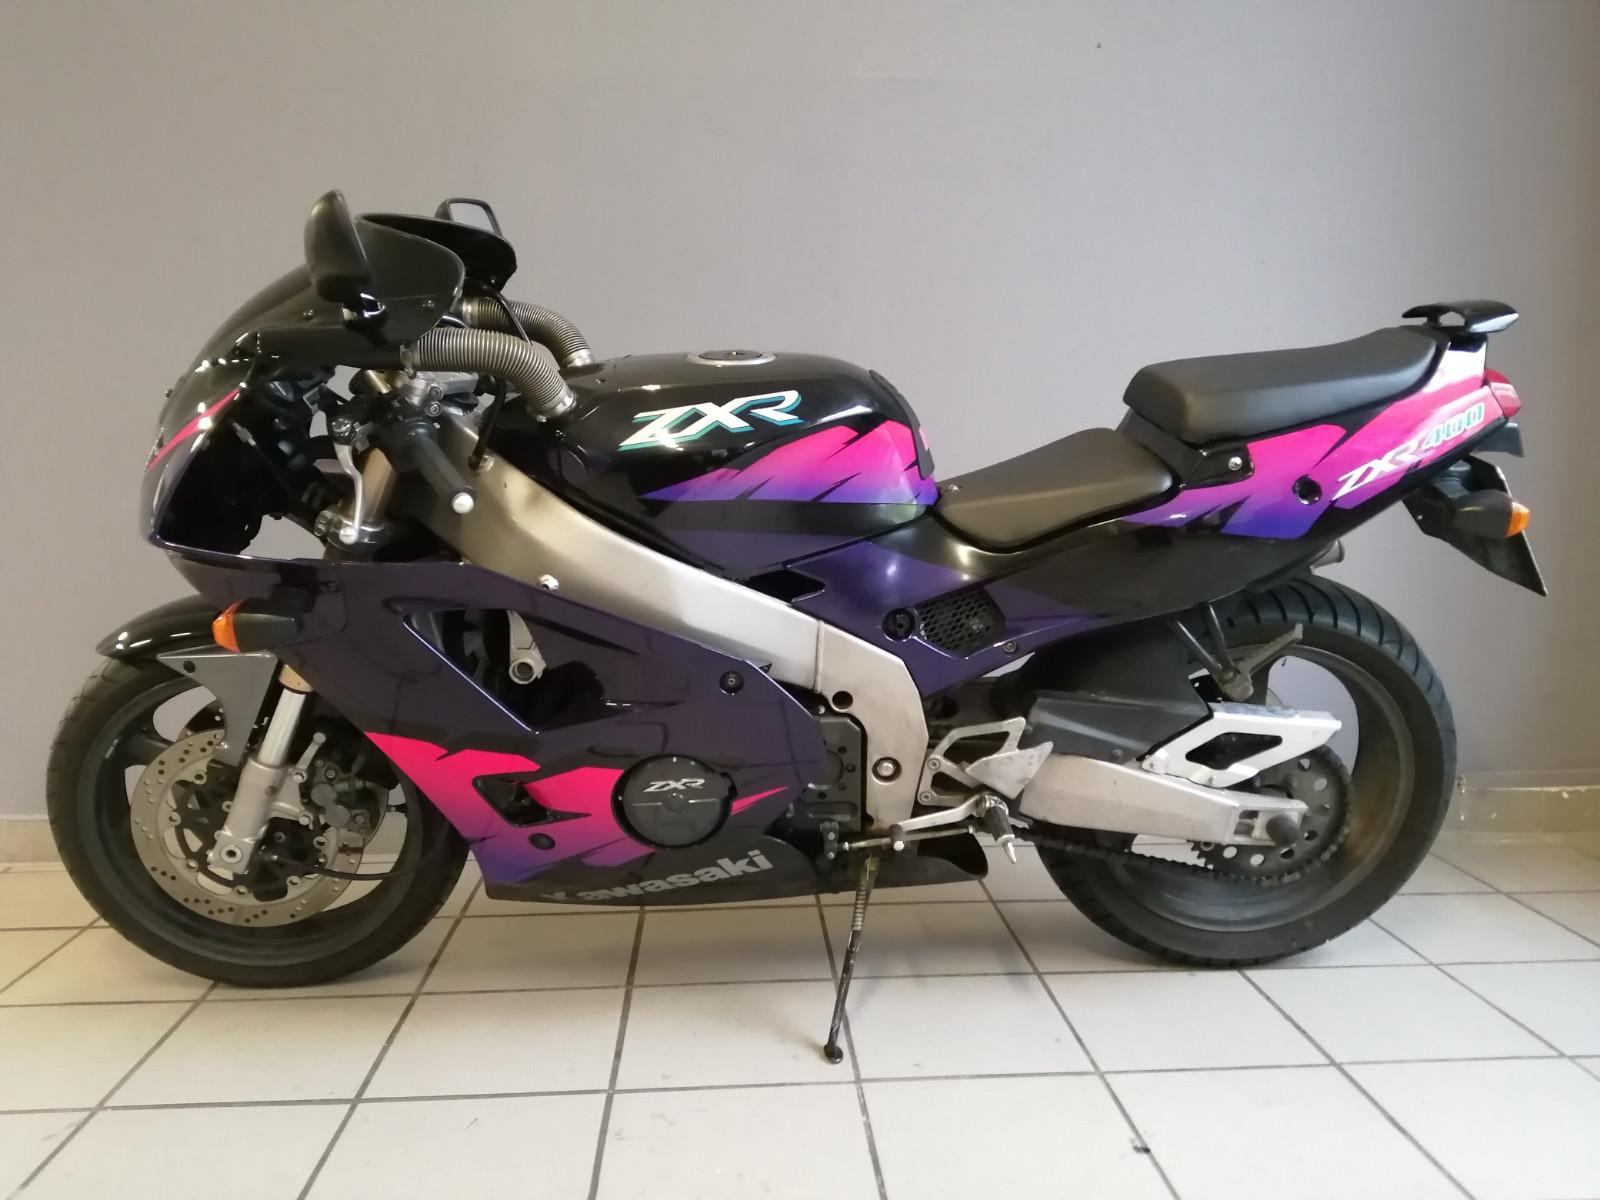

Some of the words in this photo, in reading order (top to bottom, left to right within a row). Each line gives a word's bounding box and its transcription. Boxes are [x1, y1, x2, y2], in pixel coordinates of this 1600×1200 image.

[617, 390, 803, 451] ZXR
[1332, 438, 1426, 501] ZXR
[1422, 402, 1485, 450] 400
[643, 778, 705, 793] ZXR
